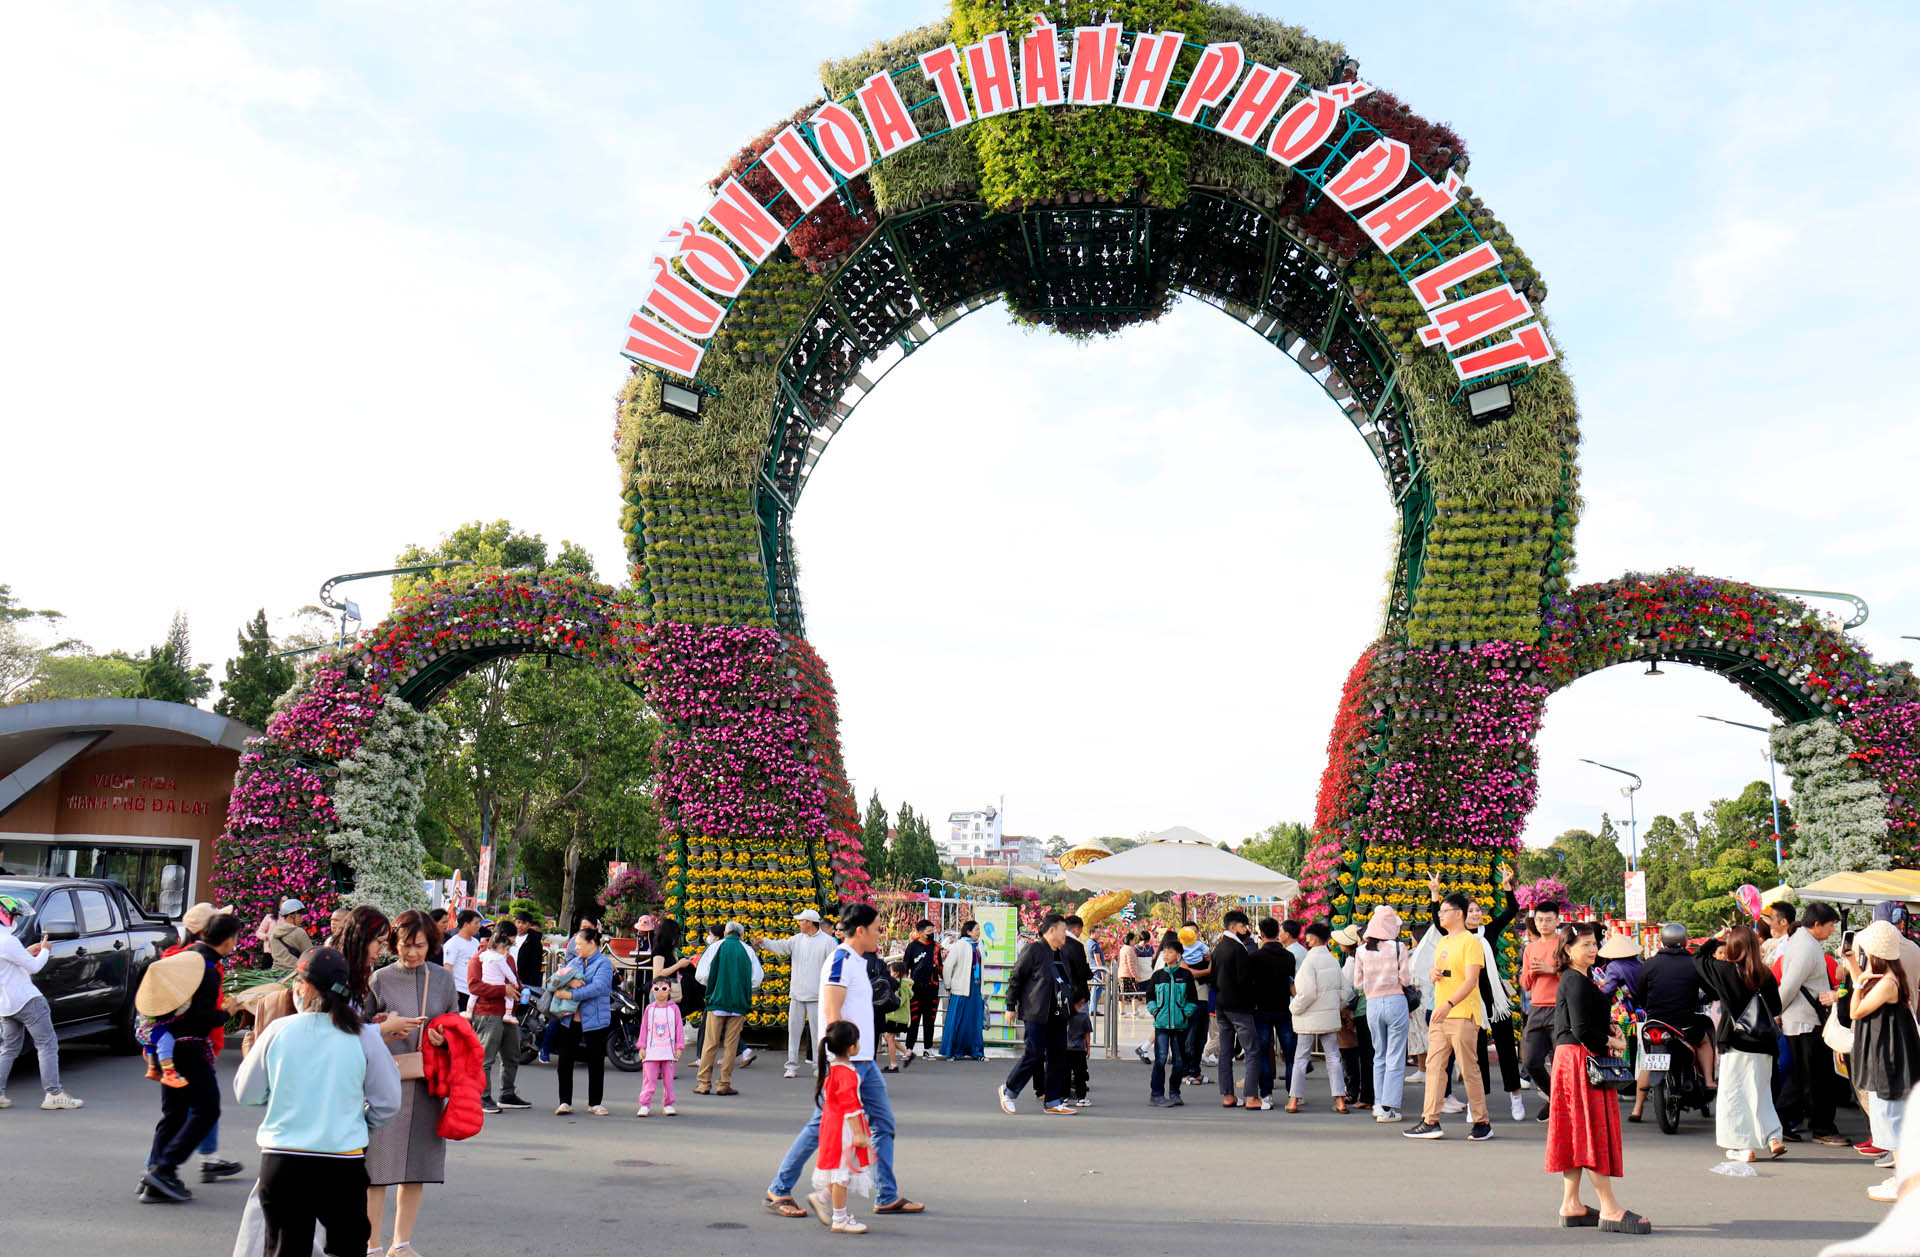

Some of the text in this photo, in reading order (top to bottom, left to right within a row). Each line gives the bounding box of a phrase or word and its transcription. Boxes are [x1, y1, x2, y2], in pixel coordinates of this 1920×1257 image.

[621, 12, 1556, 381] VƯỜN HOA THÀNH PHỐ ĐÀ LẠT
